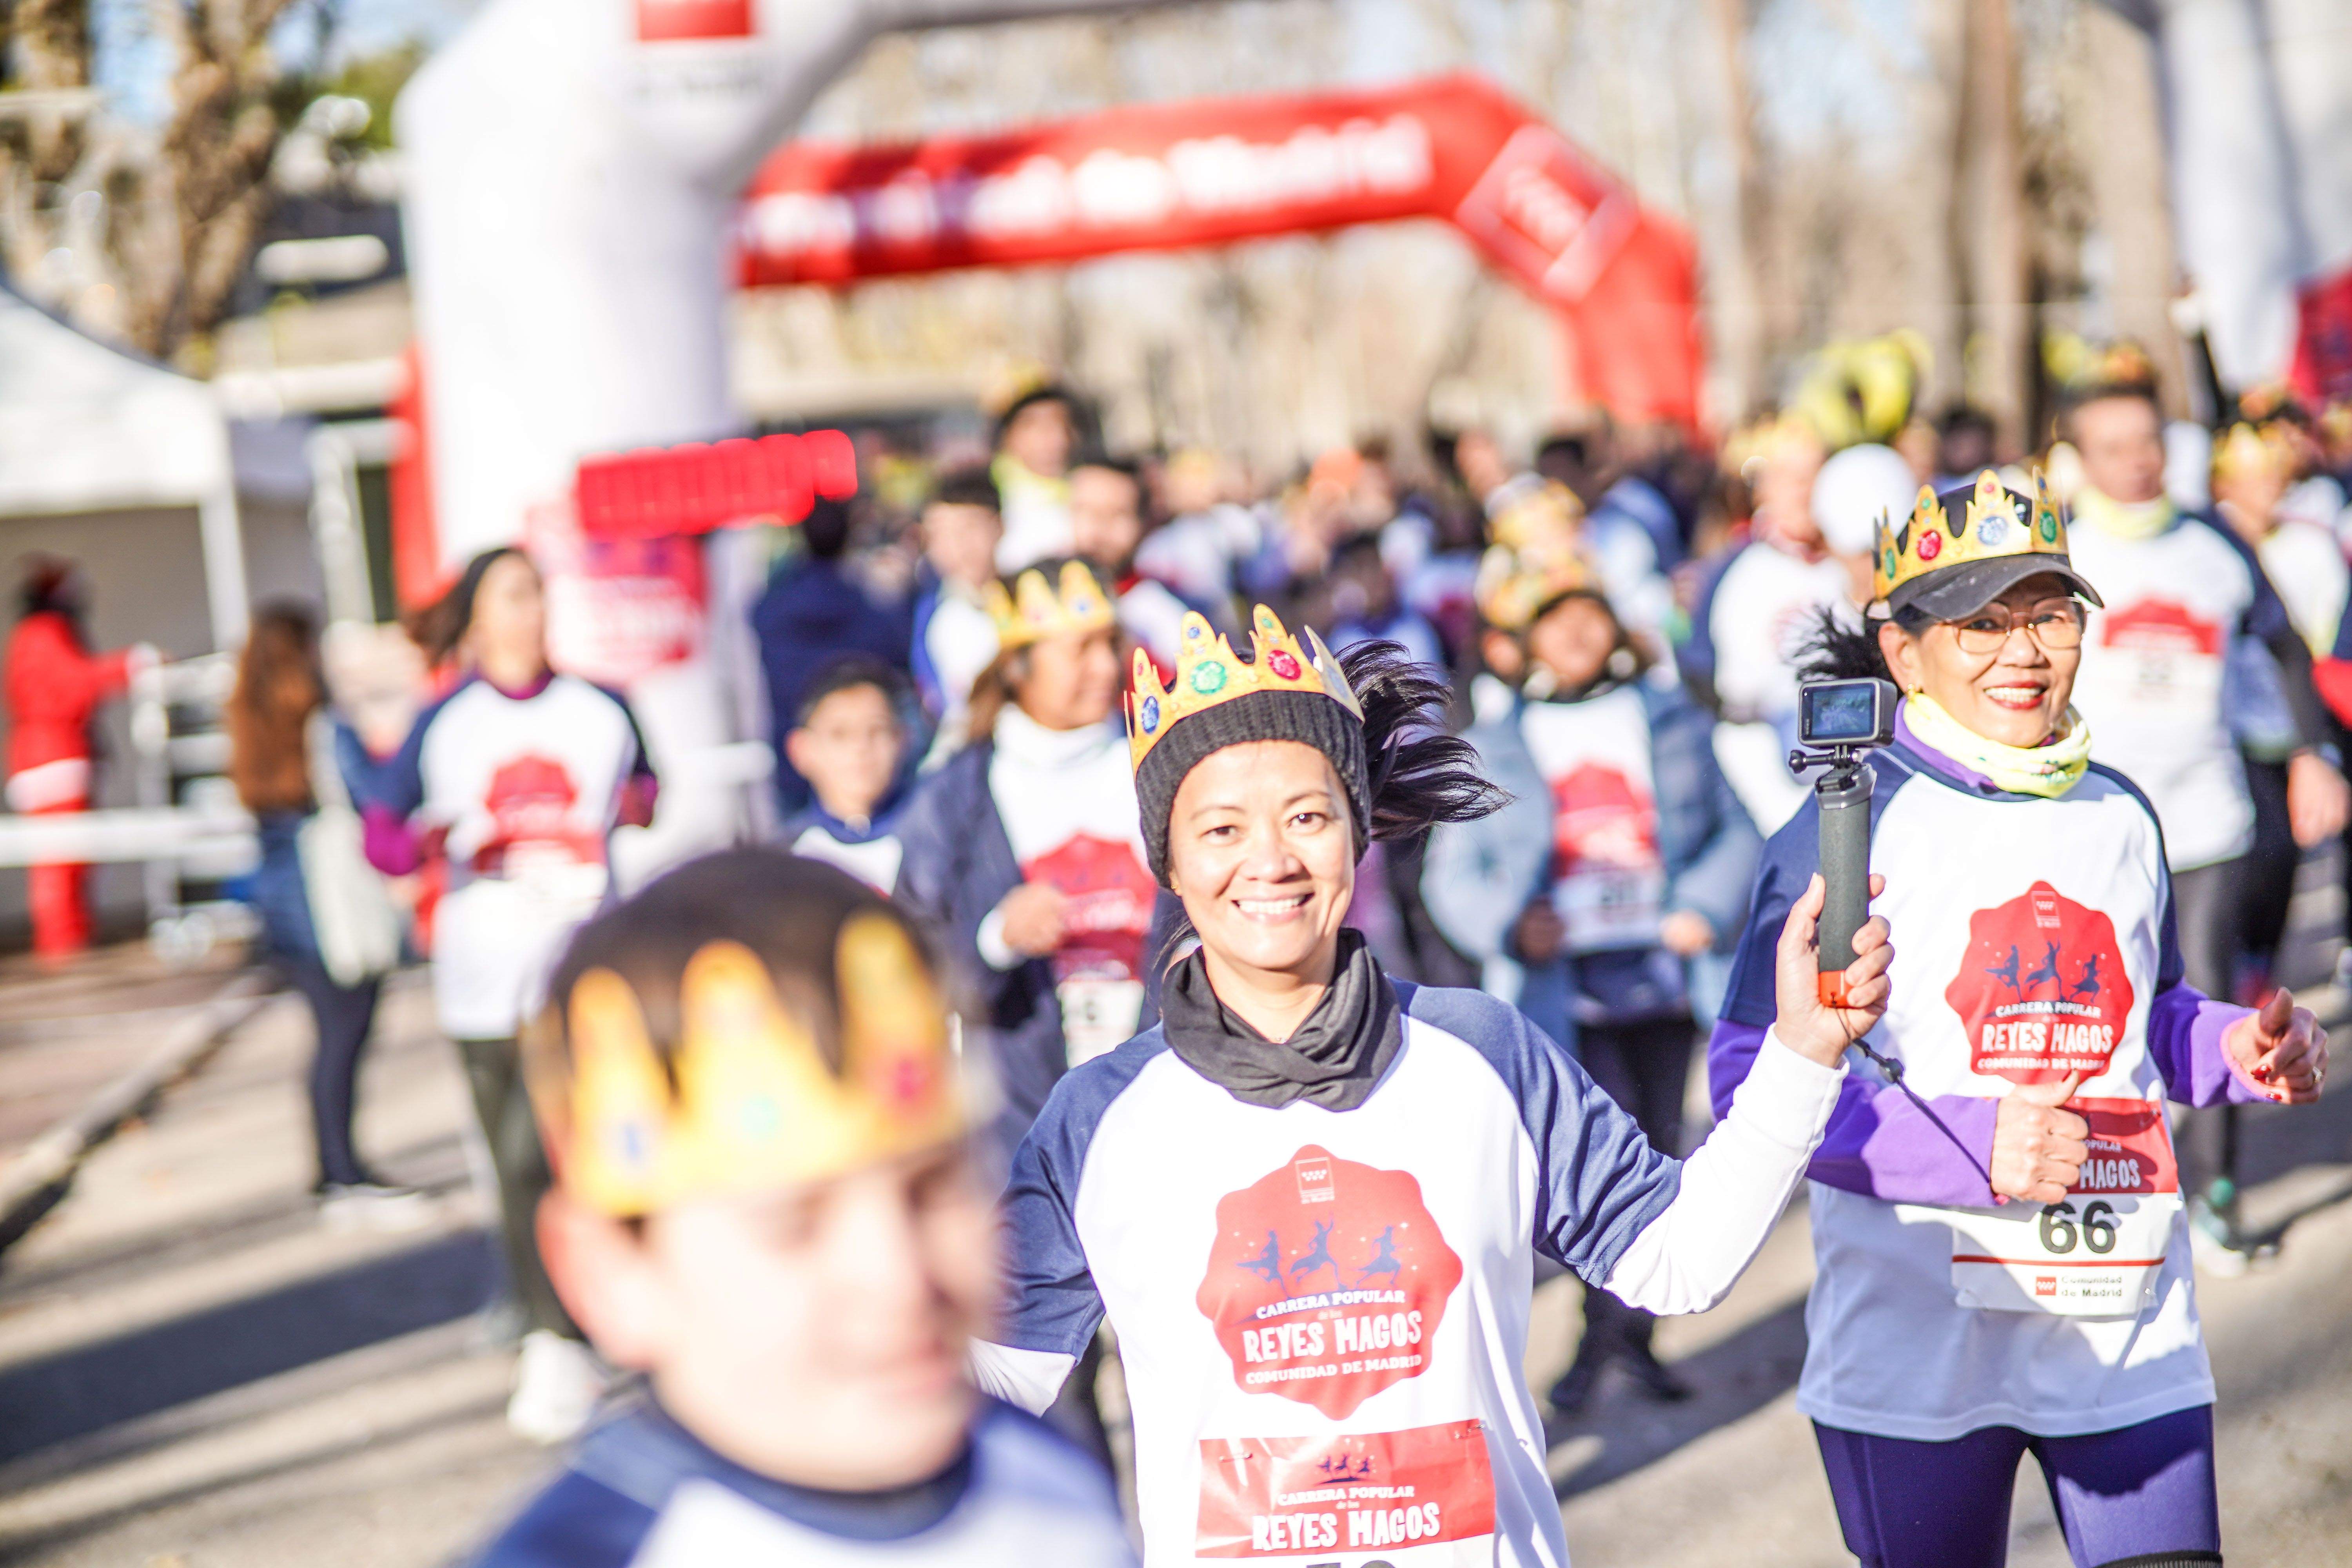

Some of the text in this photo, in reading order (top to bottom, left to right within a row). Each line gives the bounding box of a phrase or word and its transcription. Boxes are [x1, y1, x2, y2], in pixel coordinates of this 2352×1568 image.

[1995, 1001, 2102, 1018] CARRERA POPULAR
[1981, 1021, 2114, 1054] REYES MAGOS
[1977, 1058, 2049, 1070] COMUNIDAD
[2051, 1058, 2069, 1070] DE
[2079, 1158, 2141, 1190] MAGOS
[2040, 1199, 2116, 1254] 66
[2061, 1275, 2122, 1284] Comunidad
[2082, 1288, 2122, 1296] Madrid
[1256, 1290, 1406, 1319] CARRERA POPULAR
[1242, 1310, 1422, 1363] REYES MAGOS
[1245, 1354, 1422, 1385] COMUNIDAD DE MADRID
[1277, 1485, 1415, 1506] CARRERA POPULAR
[1252, 1502, 1440, 1552] REYES MAGOS
